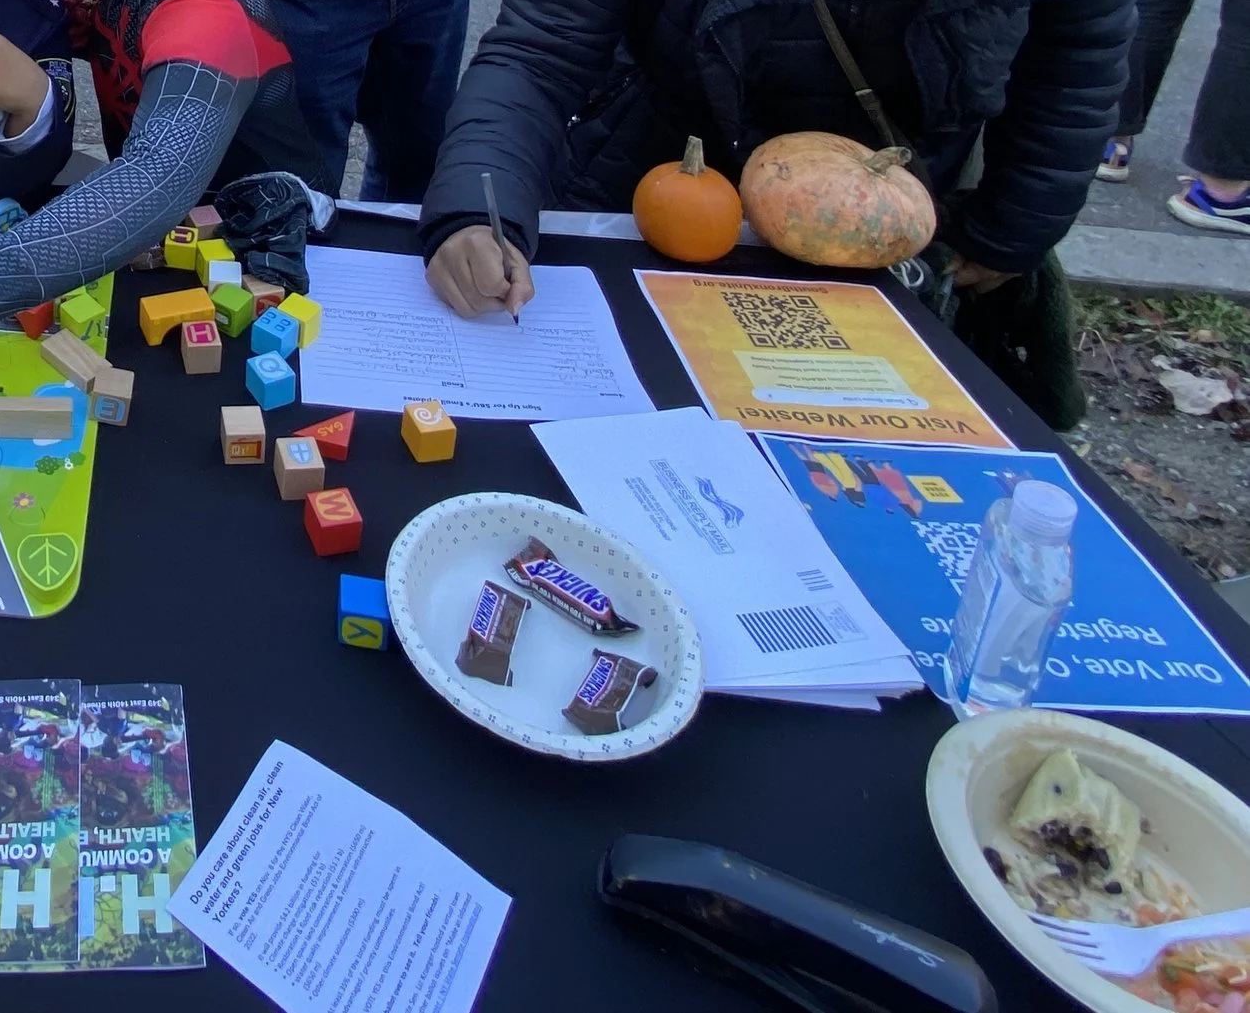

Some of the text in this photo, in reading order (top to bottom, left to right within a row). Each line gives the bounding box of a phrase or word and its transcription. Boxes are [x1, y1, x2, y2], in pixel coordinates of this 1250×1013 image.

[188, 322, 215, 343] H
[258, 356, 286, 374] Q
[441, 380, 465, 389] Email
[402, 395, 436, 404] pdates
[441, 398, 463, 407] Email
[508, 401, 520, 410] Up
[522, 403, 542, 412] Sign
[316, 420, 344, 438] GAS
[733, 406, 979, 435] Visit Our Website!
[655, 461, 693, 500] BUSINESS
[685, 501, 714, 528] REPLY
[472, 586, 499, 638] SNICKERS
[1071, 654, 1164, 680] Vote,
[1166, 660, 1223, 684] Our
[578, 656, 613, 703] SNICKERS
[5, 695, 26, 704] 140th
[27, 694, 44, 702] East
[45, 694, 60, 703] 349
[107, 699, 128, 709] 140th
[129, 699, 147, 707] East
[147, 699, 162, 708] 349
[93, 825, 171, 844] HEALTH,
[189, 759, 284, 905] Do you care about clean air, clean
[41, 842, 56, 859] A
[157, 847, 172, 864] A
[201, 786, 284, 916] water and green jobs for New
[212, 879, 244, 926] Yorkers?
[237, 904, 250, 921] vote
[245, 890, 258, 907] YES
[423, 892, 440, 919] friends!
[417, 916, 431, 935] your
[412, 932, 423, 948] Tell
[391, 977, 404, 996] over
